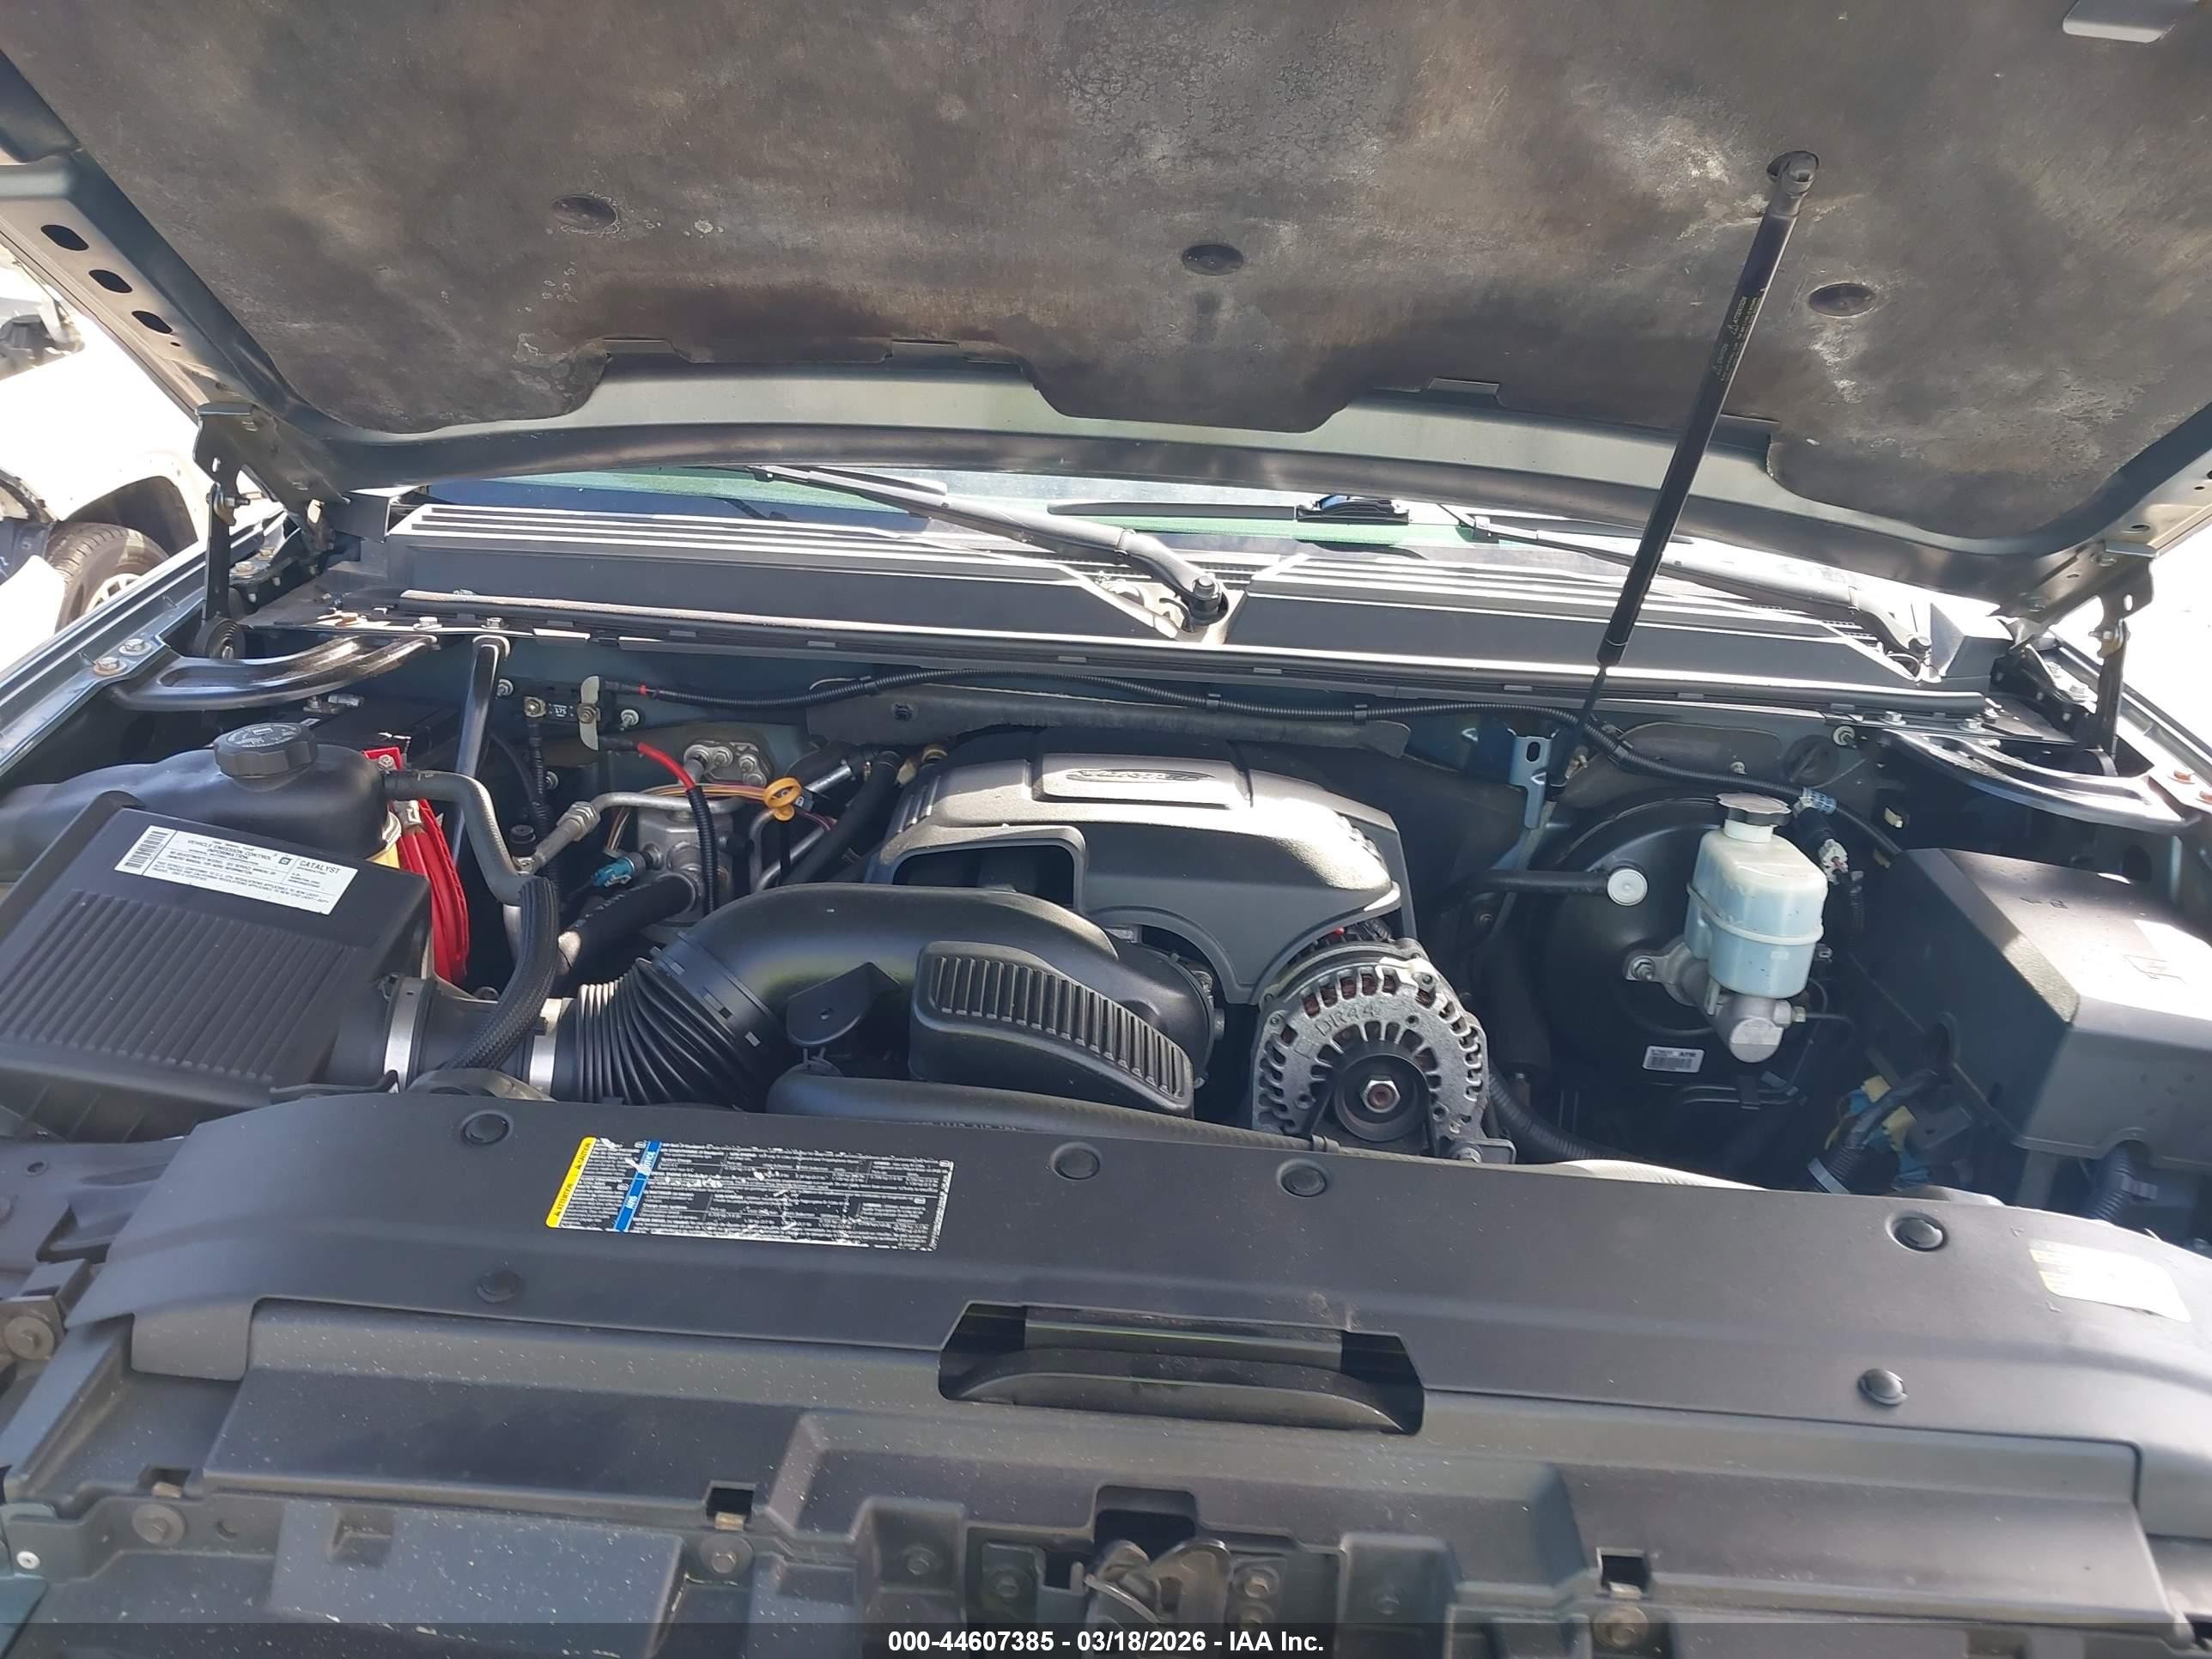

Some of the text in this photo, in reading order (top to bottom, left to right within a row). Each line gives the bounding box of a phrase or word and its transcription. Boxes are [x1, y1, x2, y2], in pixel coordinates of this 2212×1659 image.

[186, 839, 213, 848] VEHICLE
[212, 845, 243, 854] EMISSION
[244, 851, 272, 860] CONTROL
[206, 848, 249, 860] INFORMATION
[299, 860, 342, 874] CATALYST
